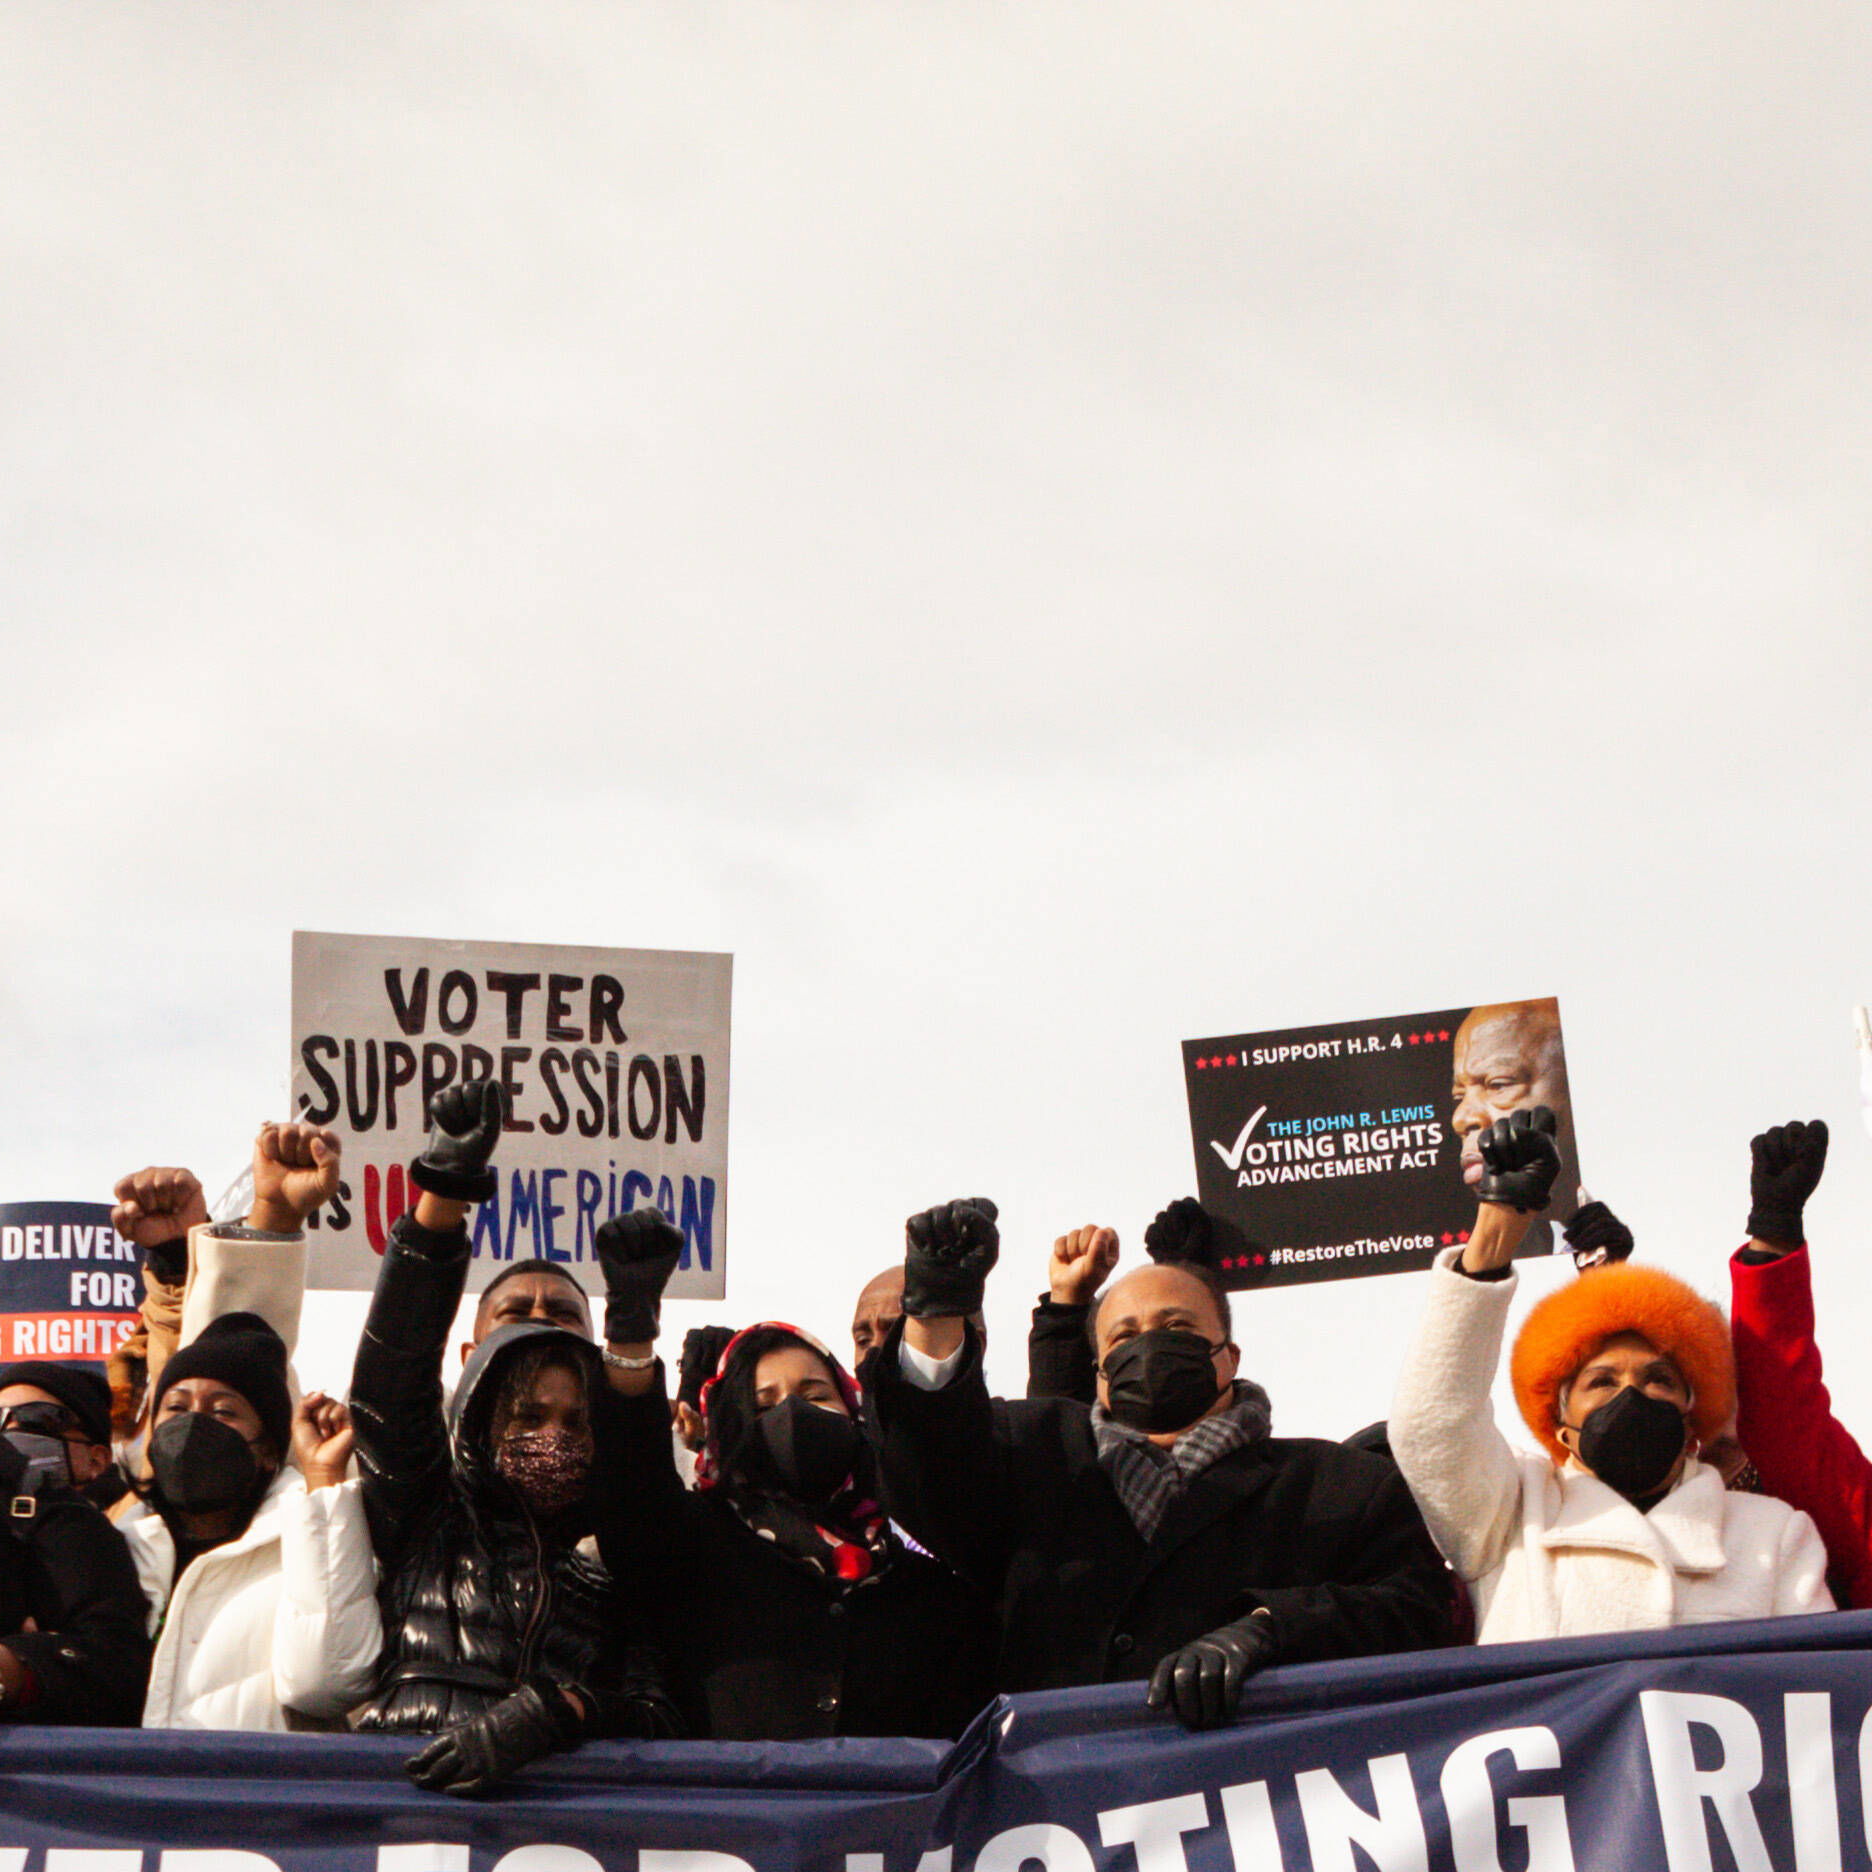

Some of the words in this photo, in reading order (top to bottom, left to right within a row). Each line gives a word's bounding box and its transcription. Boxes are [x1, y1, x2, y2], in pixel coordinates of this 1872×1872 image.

[384, 967, 628, 1045] VOTER
[1241, 1051, 1248, 1066] I
[1252, 1040, 1341, 1066] SUPPORT
[1347, 1036, 1386, 1055] H.R.
[1390, 1033, 1403, 1049] 4
[1267, 1119, 1301, 1137] THE
[1306, 1113, 1354, 1136] JOHN
[1359, 1111, 1376, 1127] R.
[1381, 1105, 1435, 1124] LEWIS
[1343, 1123, 1443, 1155] RIGHTS
[1236, 1153, 1394, 1188] ADVANCEMENT
[1400, 1149, 1439, 1169] ACT
[1269, 1234, 1434, 1266] #RestoreTheVote
[70, 1272, 136, 1307] FOR
